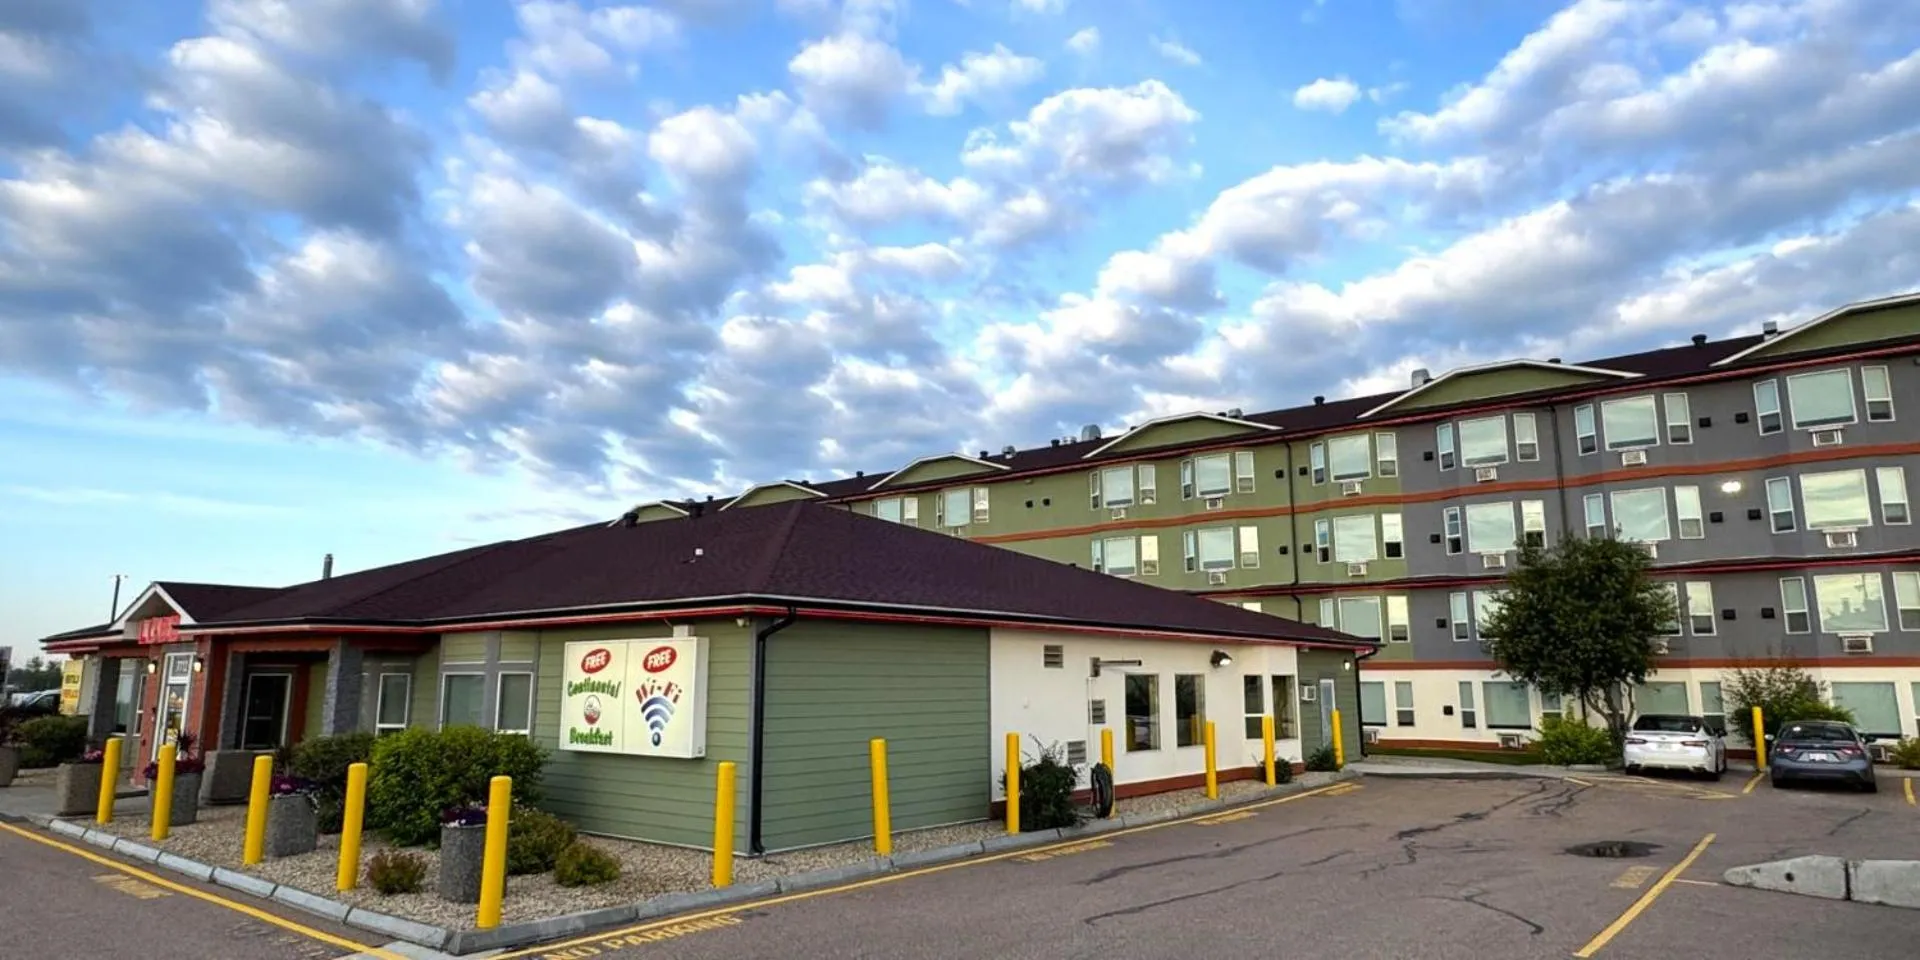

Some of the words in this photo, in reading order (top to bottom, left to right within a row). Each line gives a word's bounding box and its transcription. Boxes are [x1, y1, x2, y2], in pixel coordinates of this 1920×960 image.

[584, 653, 607, 669] FREE
[647, 650, 673, 669] FREE
[567, 676, 622, 698] Continental
[569, 727, 613, 746] Breakfast
[601, 913, 742, 949] PARKING
